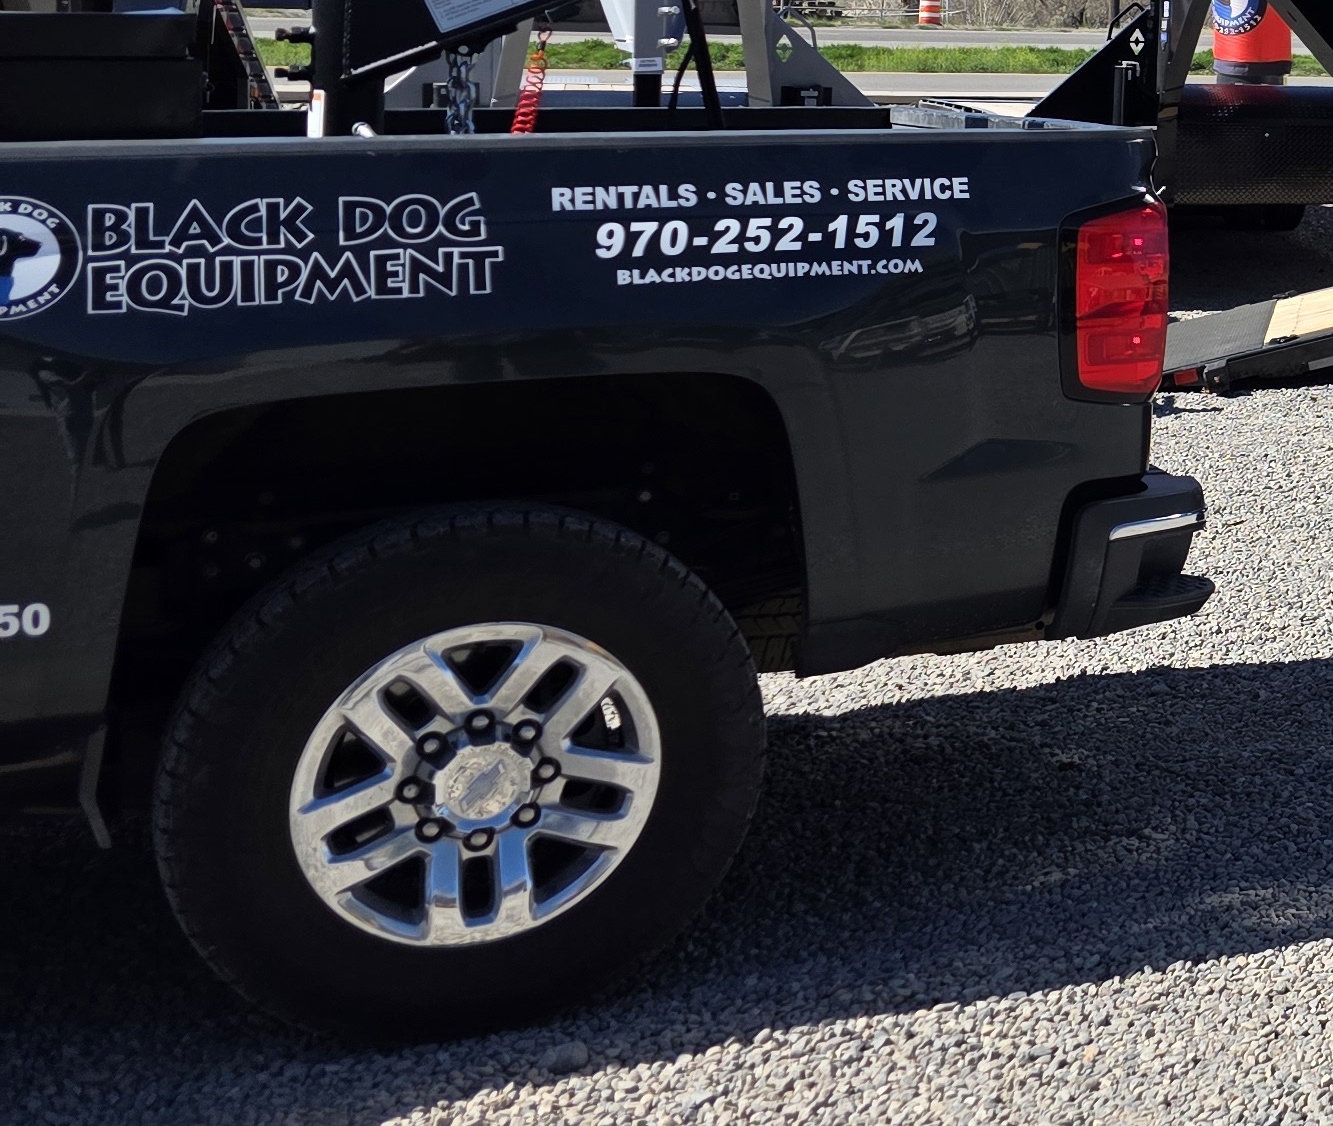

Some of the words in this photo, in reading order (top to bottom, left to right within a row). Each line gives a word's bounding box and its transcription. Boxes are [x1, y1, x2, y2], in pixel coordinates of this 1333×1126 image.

[551, 183, 698, 212] RENTALS
[724, 180, 821, 206] SALES
[847, 177, 970, 202] SERVICE
[17, 203, 60, 229] DOG
[87, 196, 315, 256] BLACK
[338, 191, 487, 245] DOG
[595, 212, 938, 259] 970-252-1512
[87, 245, 504, 316] EQUIPMENT
[616, 258, 924, 286] BLACKDOGEQUIPMENT.COM
[0, 602, 51, 638] 50
